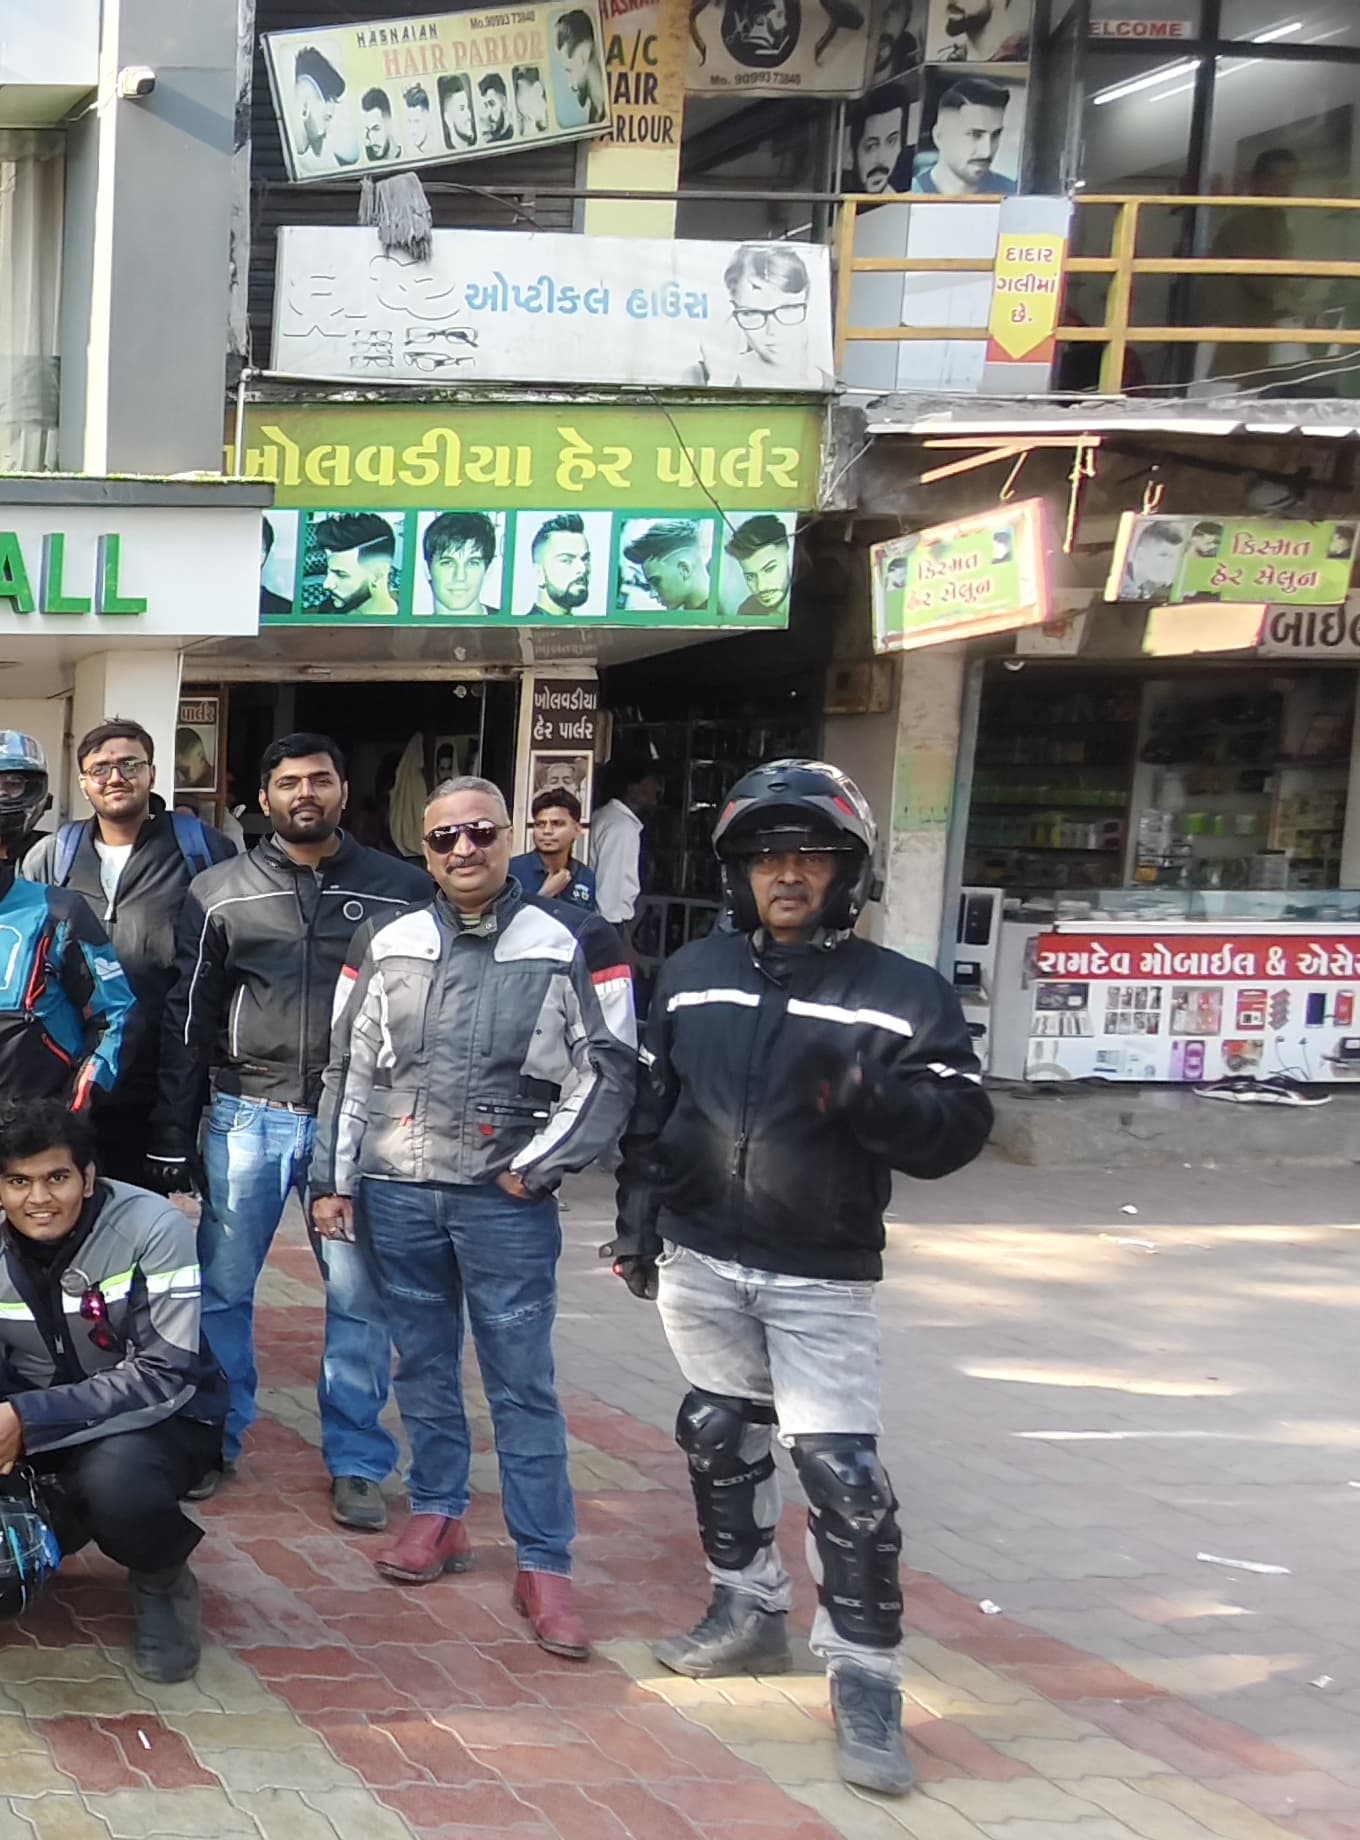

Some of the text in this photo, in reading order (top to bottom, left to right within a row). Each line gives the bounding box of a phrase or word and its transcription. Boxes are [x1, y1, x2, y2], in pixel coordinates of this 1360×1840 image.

[1088, 21, 1185, 37] ELCOME
[383, 31, 544, 78] HAIR PARLOR
[605, 28, 659, 71] A/C
[600, 114, 675, 145] RLOUR
[555, 425, 634, 491] હેર
[656, 427, 800, 489] પાર્લર
[1211, 563, 1242, 587] હેર
[1264, 608, 1360, 649] બાઈ
[533, 714, 593, 741] હેર પાર્લર
[1037, 942, 1130, 975] રામદેવ
[1265, 945, 1286, 975] &
